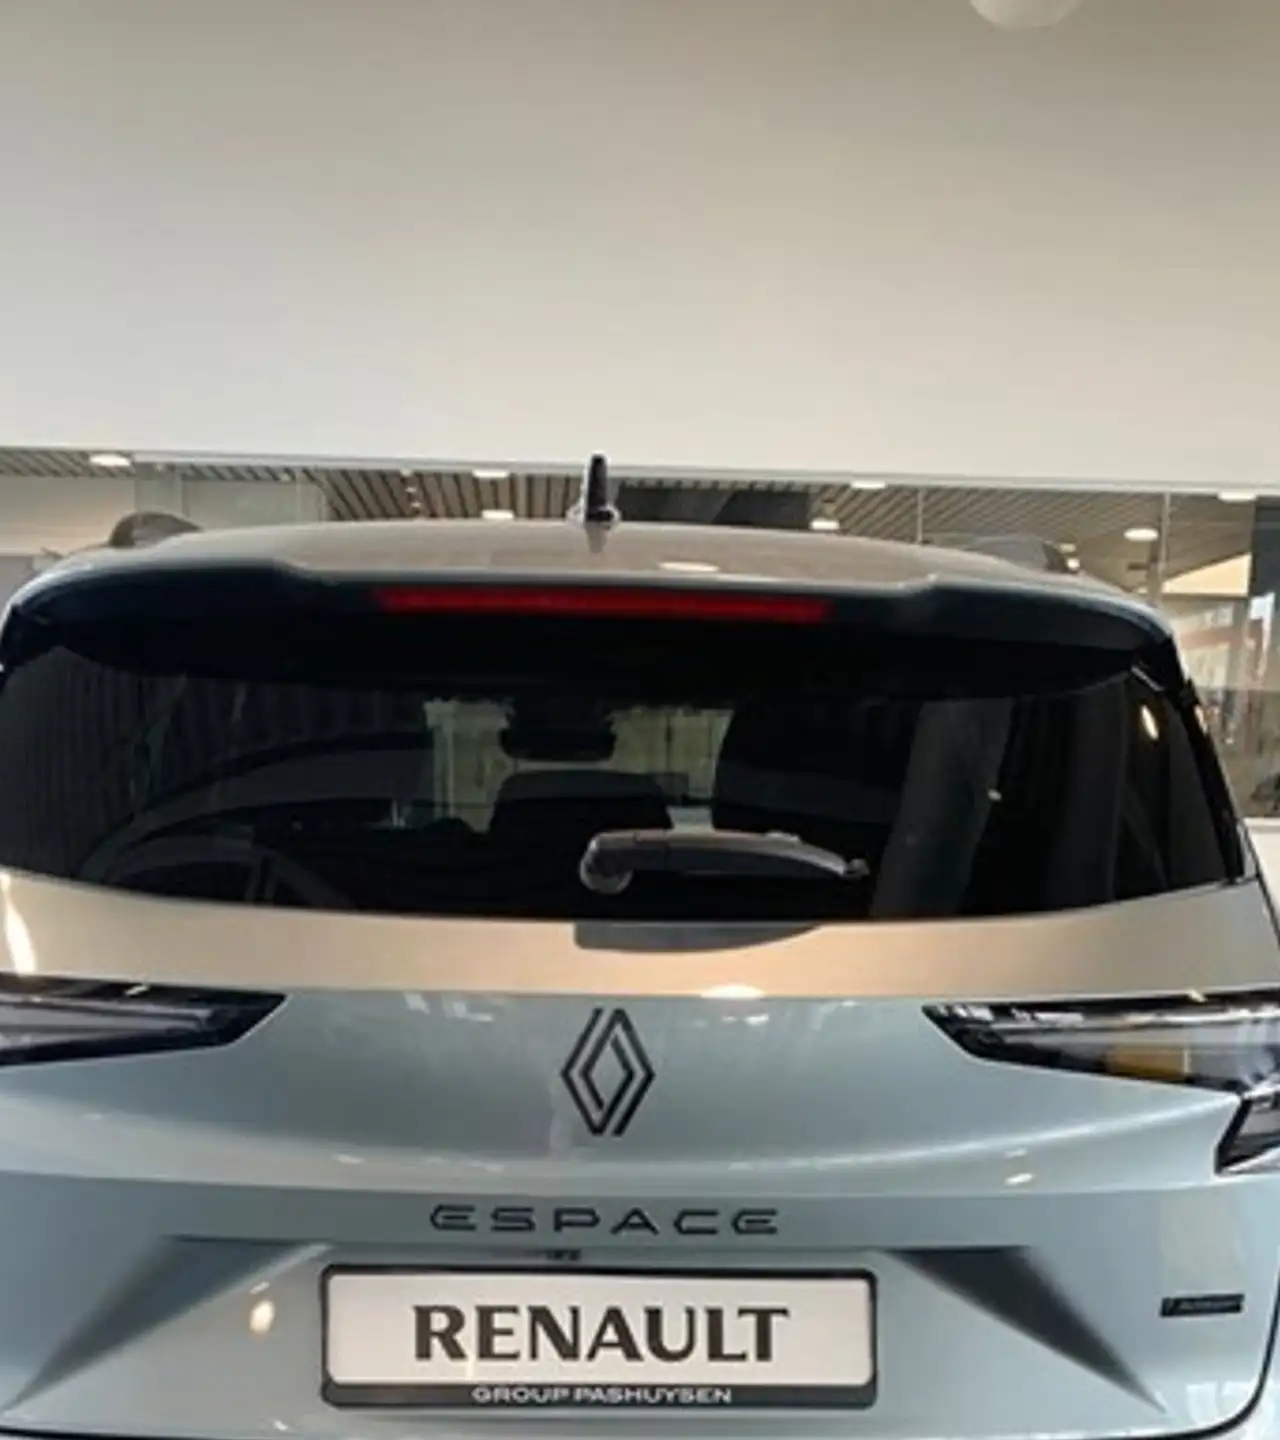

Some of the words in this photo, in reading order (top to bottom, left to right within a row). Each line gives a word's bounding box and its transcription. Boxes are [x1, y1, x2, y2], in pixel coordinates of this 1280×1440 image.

[429, 1205, 778, 1235] ESPACE
[413, 1305, 791, 1362] RENAULT
[471, 1387, 569, 1404] GROUP
[575, 1387, 732, 1404] PASHUYSEN
